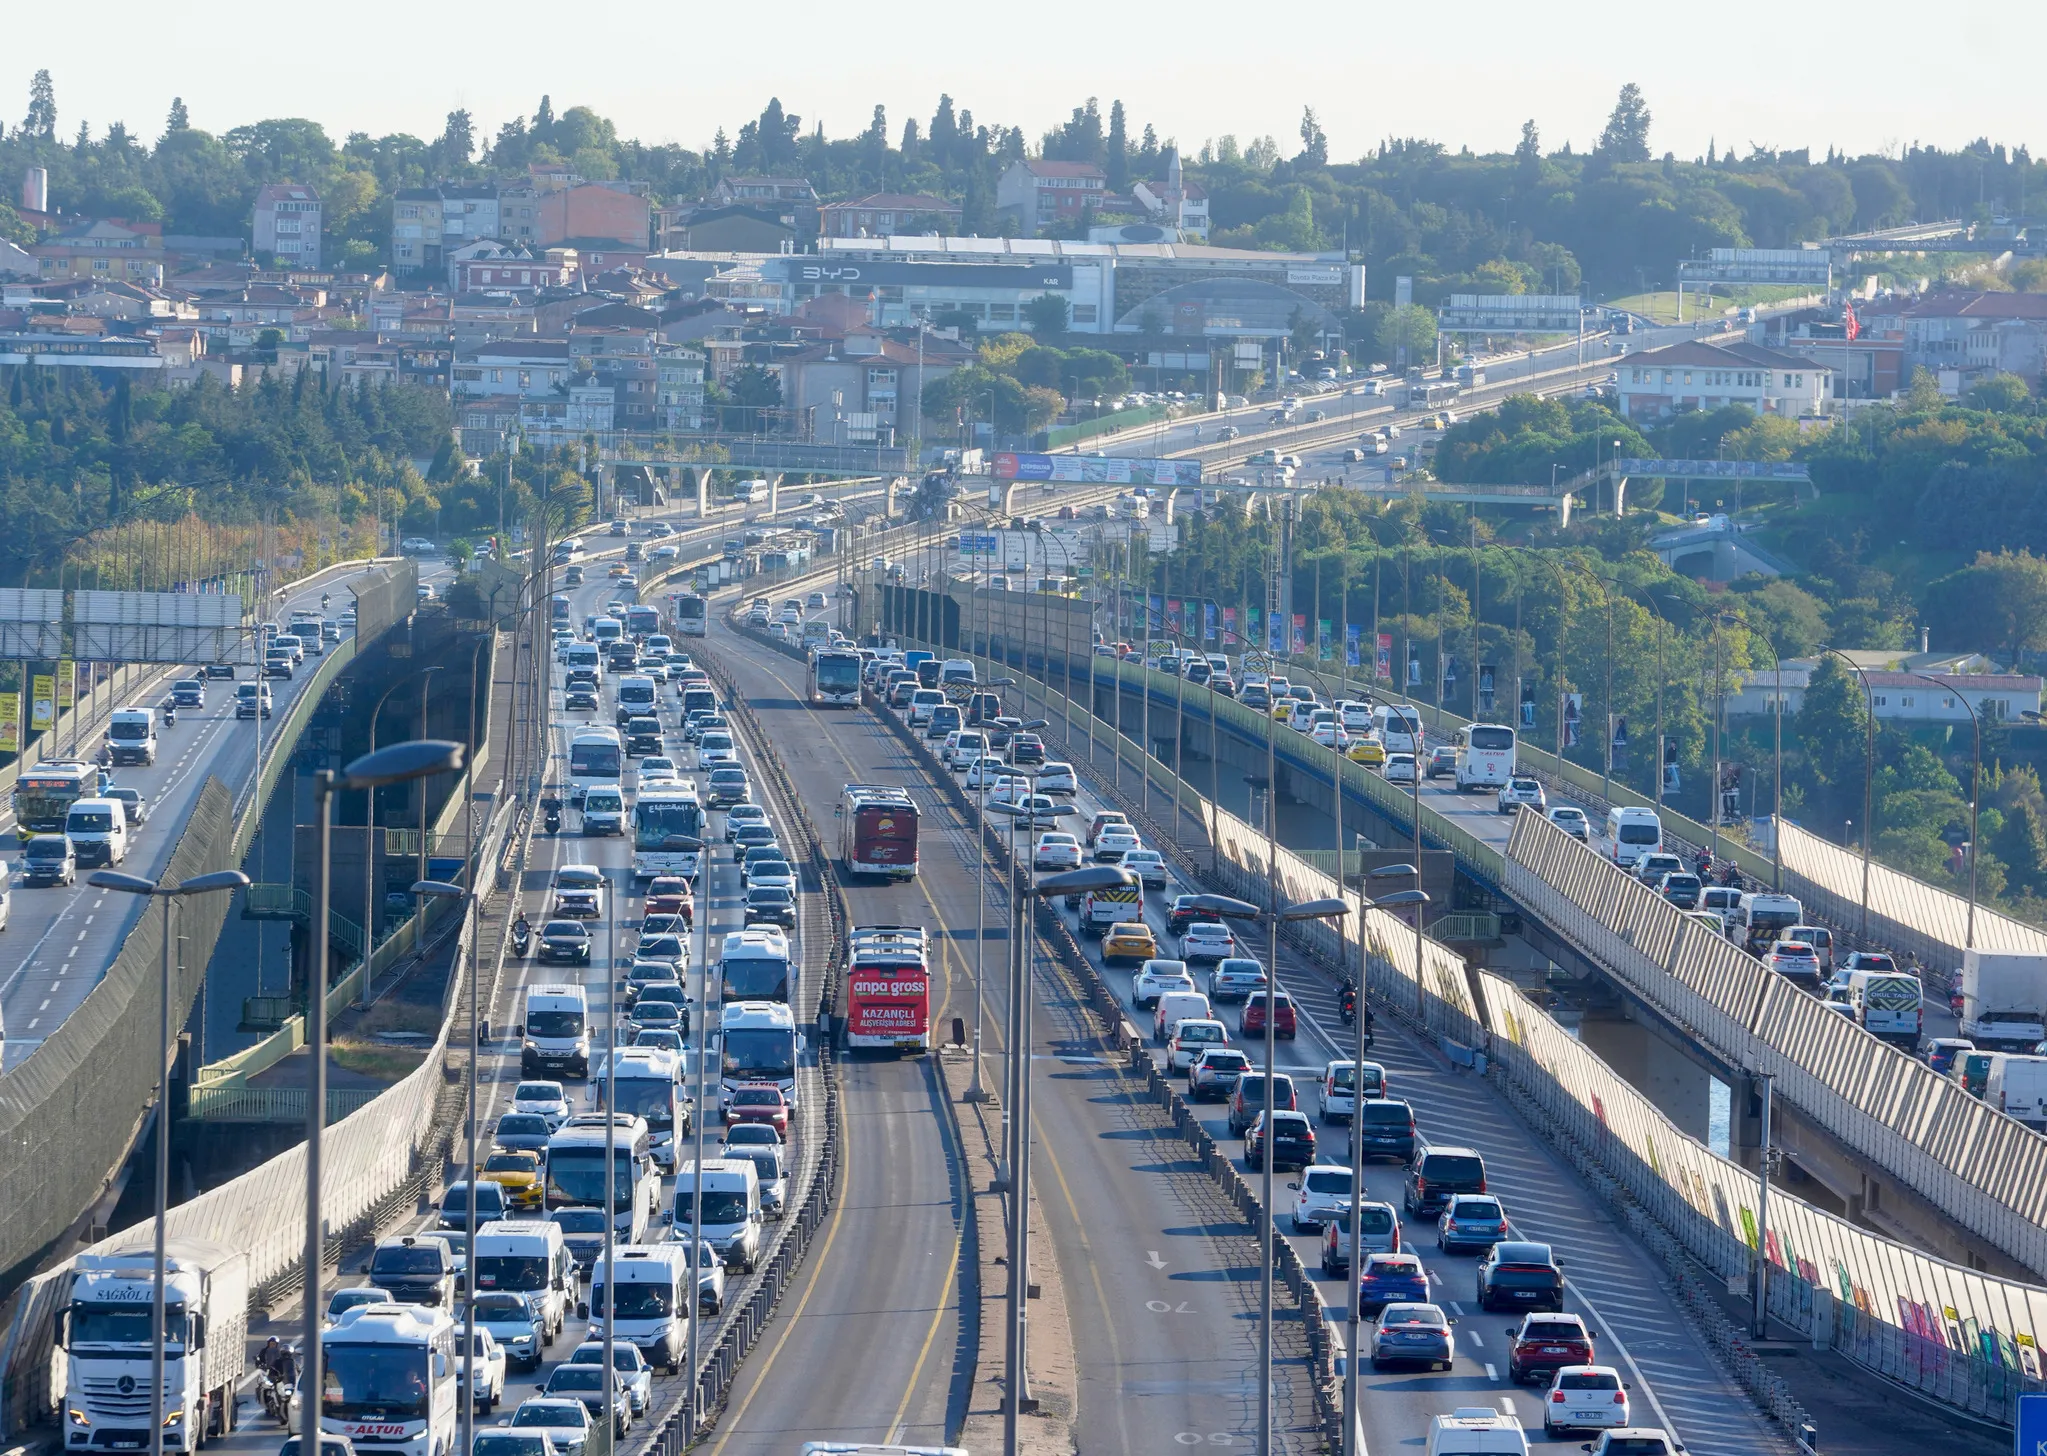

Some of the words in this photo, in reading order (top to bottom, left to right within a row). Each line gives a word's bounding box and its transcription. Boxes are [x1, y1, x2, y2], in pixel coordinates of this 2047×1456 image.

[803, 266, 861, 280] BYD
[1290, 273, 1310, 281] Toyota
[1043, 278, 1059, 286] KAR
[854, 982, 888, 996] anpa
[890, 982, 925, 996] gross
[862, 1009, 915, 1020] KAZANÇLI
[354, 1424, 405, 1435] ALTUR
